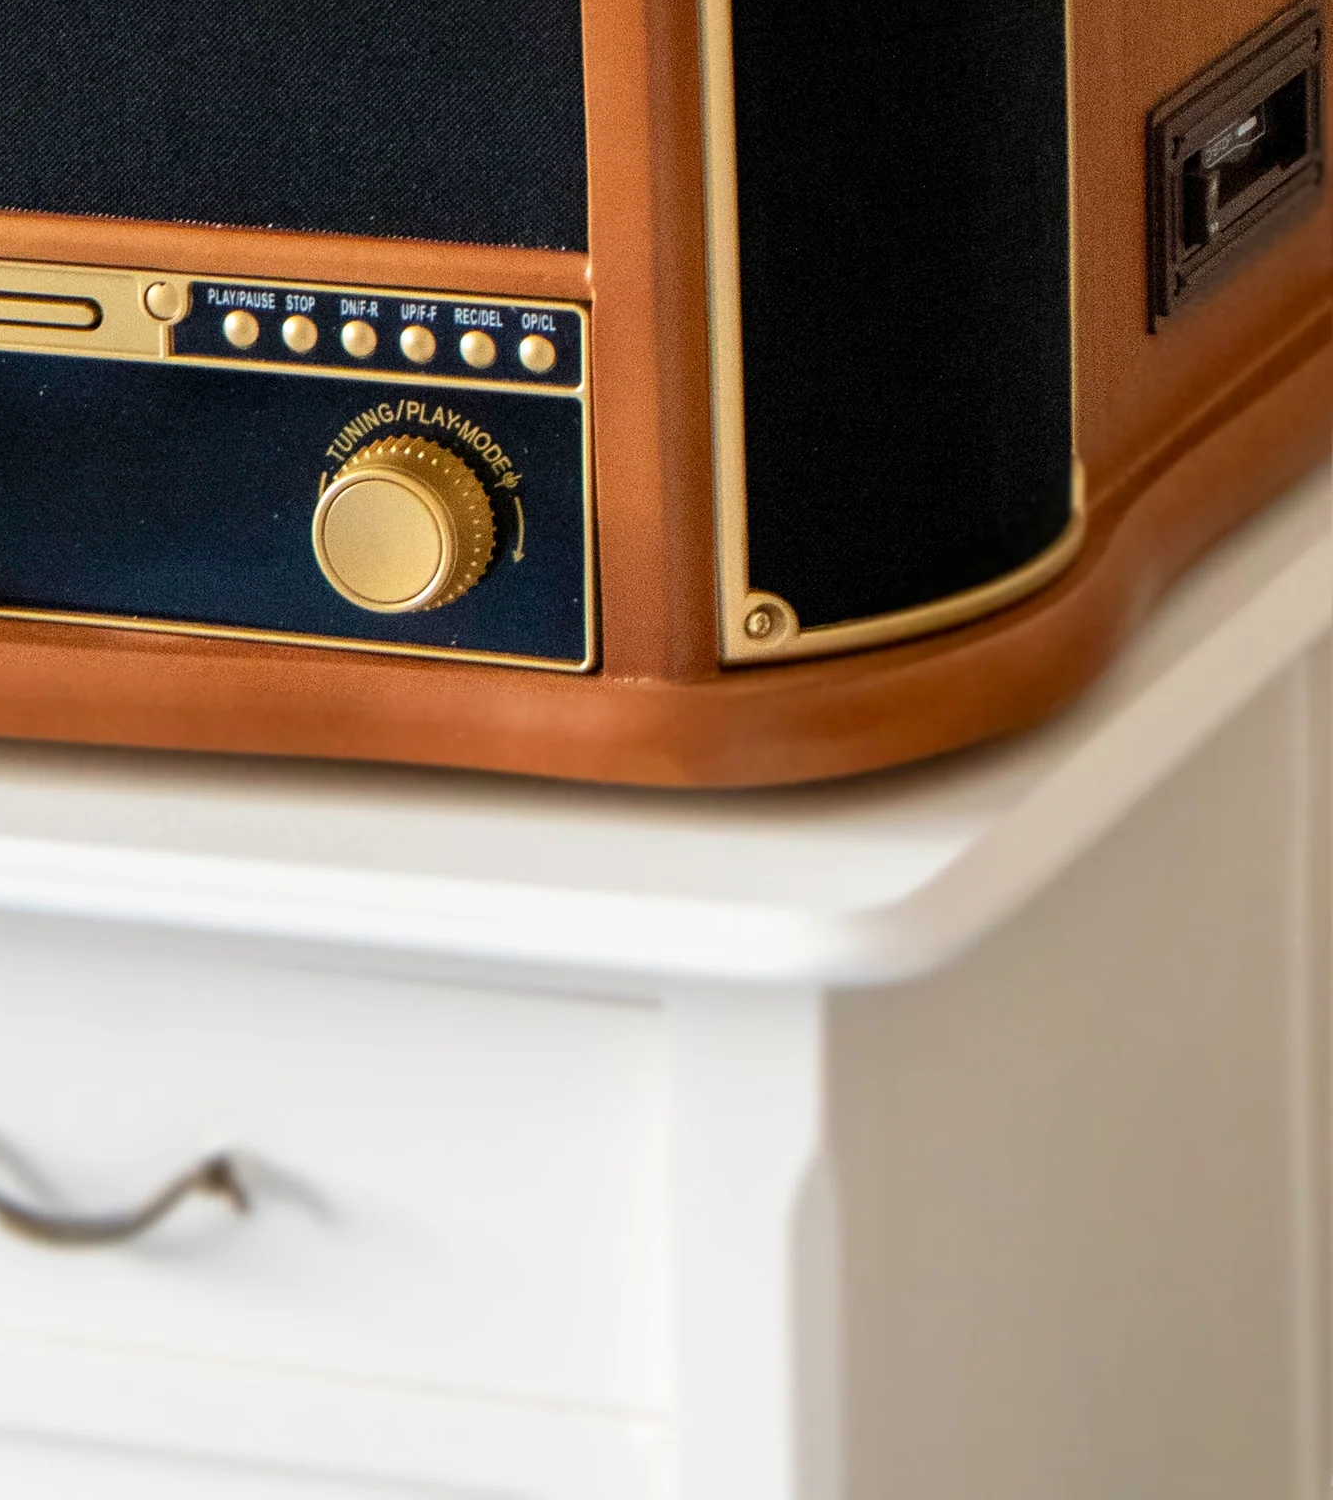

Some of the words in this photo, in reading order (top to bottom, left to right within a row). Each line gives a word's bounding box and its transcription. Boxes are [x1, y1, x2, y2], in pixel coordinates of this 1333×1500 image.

[207, 287, 276, 310] PLAY/PAUSE
[285, 294, 316, 313] STOP
[339, 299, 379, 318] DN/F-R
[454, 307, 504, 328] REC/DEL
[521, 312, 557, 332] OP/CL
